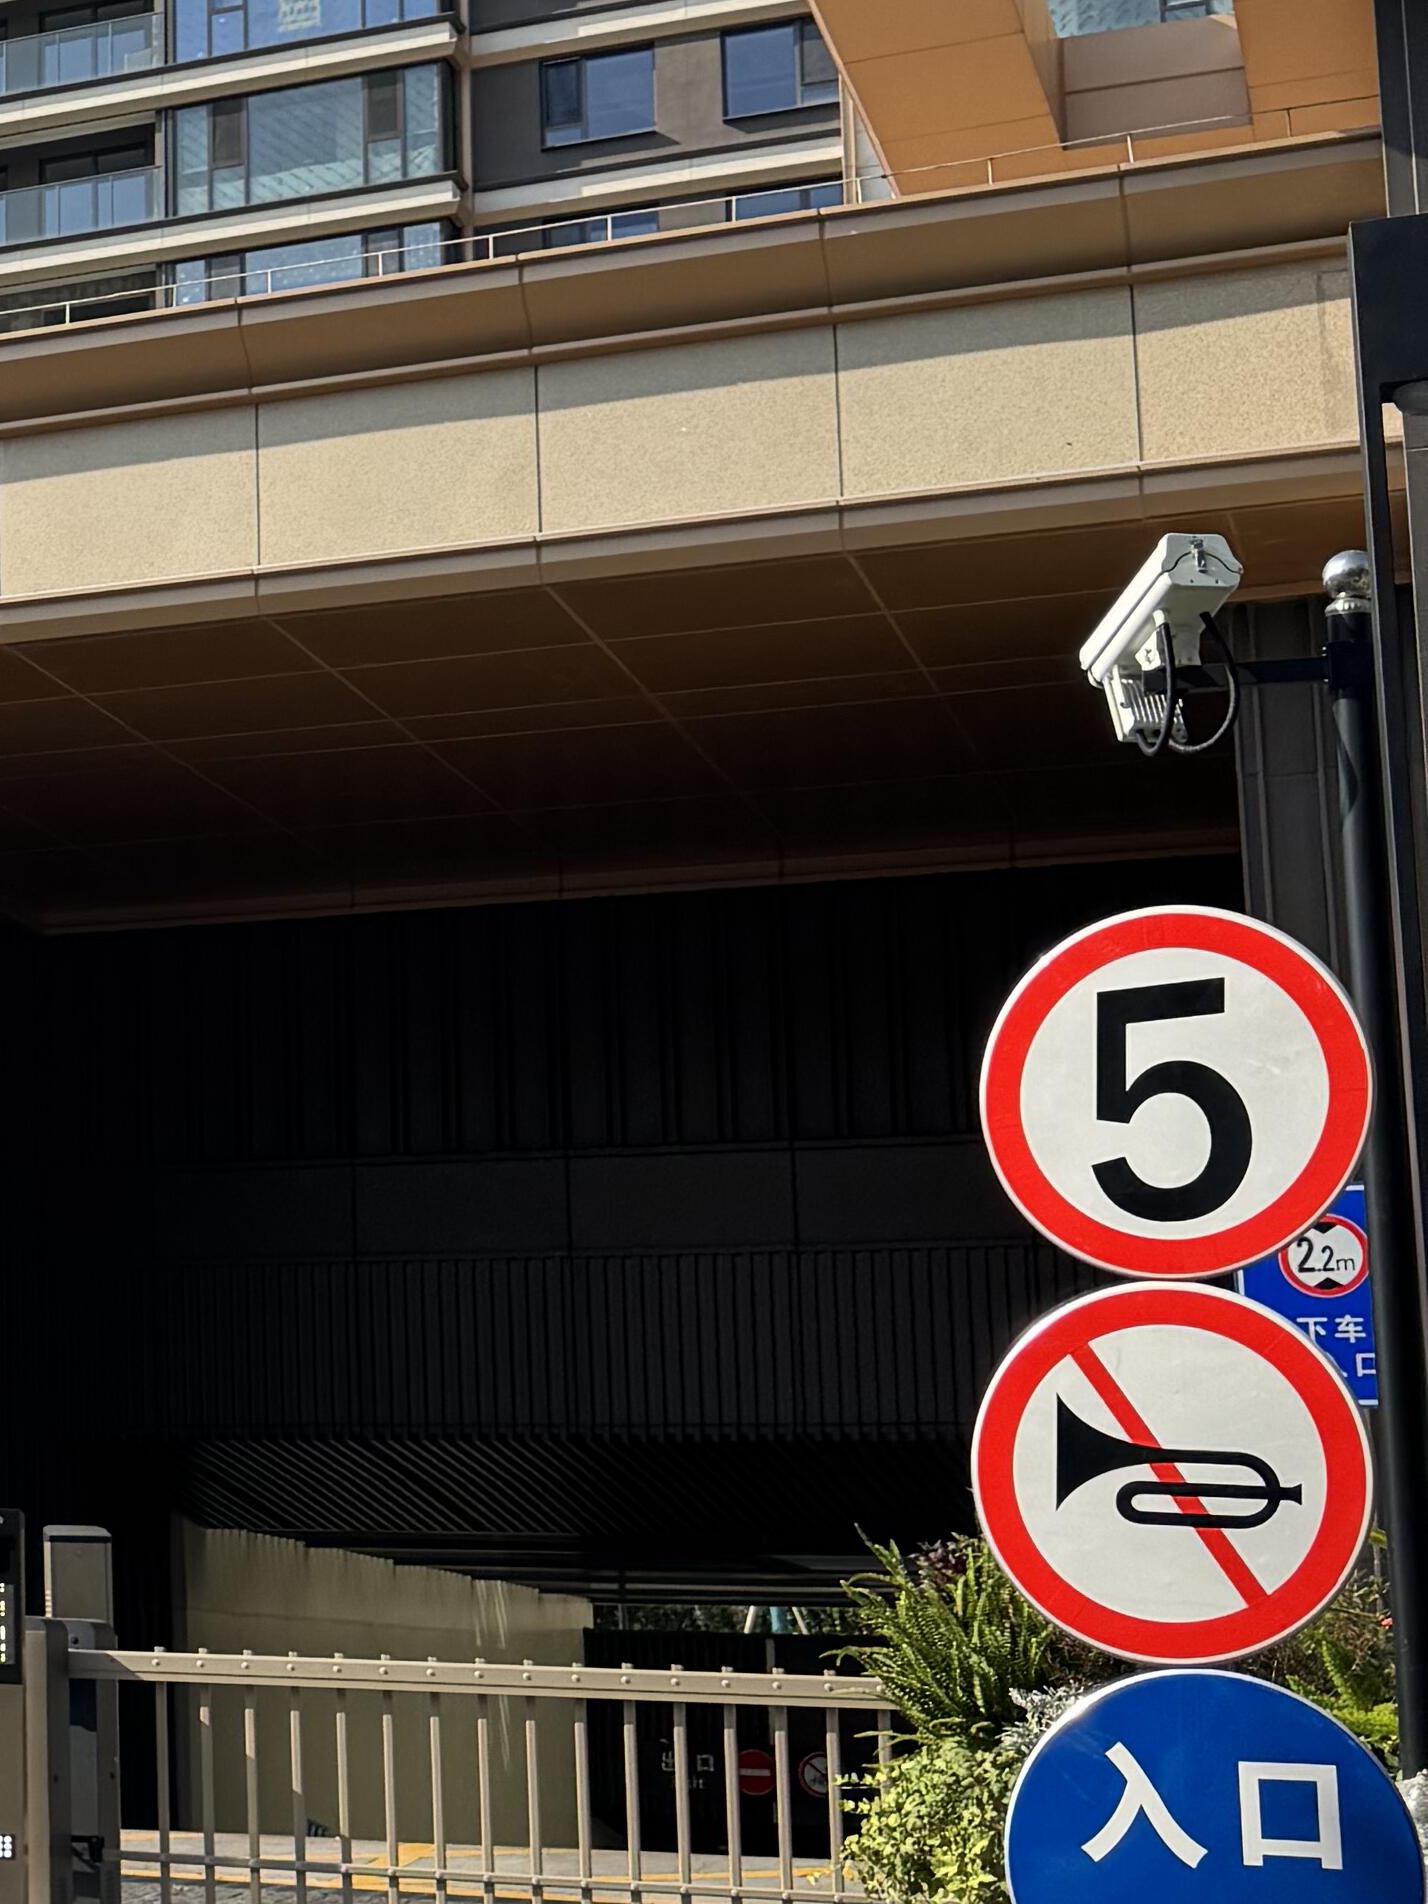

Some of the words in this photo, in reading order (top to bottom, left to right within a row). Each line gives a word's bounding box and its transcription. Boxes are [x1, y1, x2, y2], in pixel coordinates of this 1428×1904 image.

[1091, 976, 1253, 1222] 5
[1296, 1236, 1356, 1274] 2.2m
[1081, 1740, 1344, 1870] 入口
